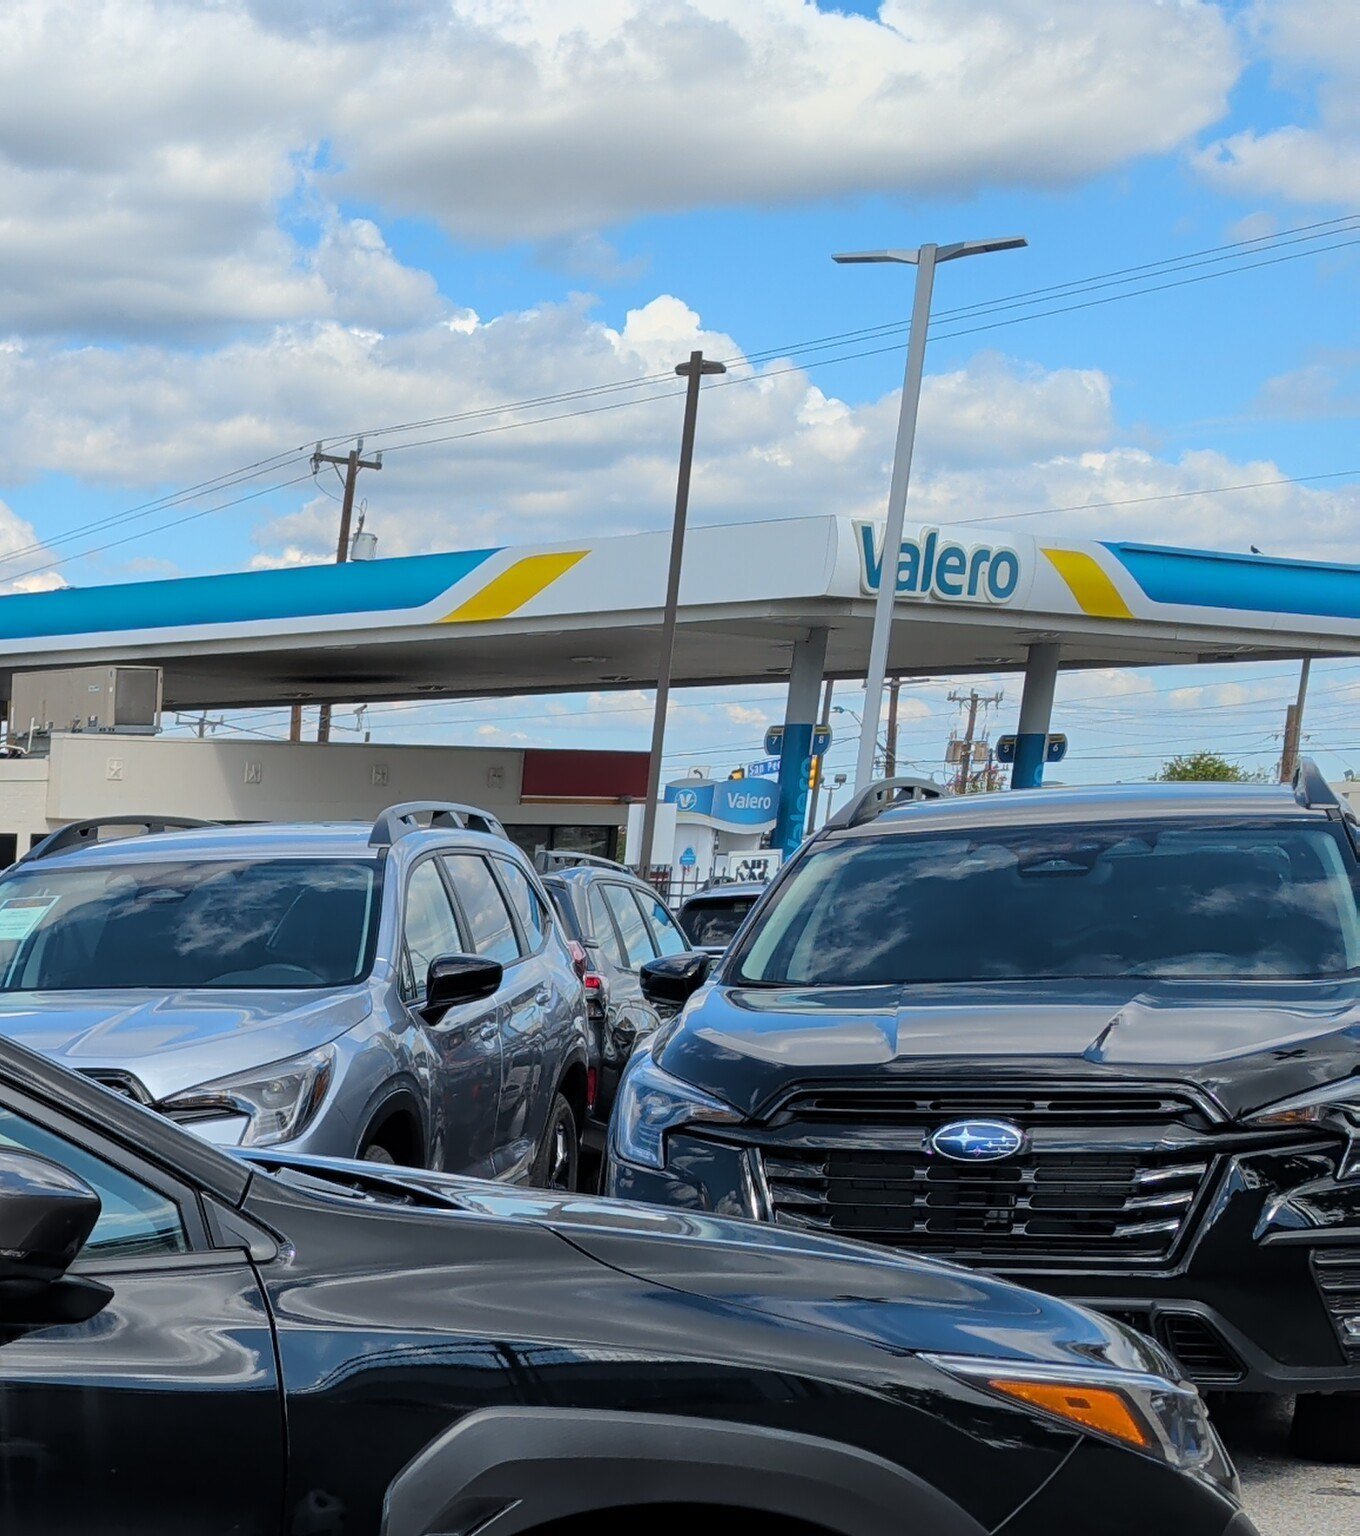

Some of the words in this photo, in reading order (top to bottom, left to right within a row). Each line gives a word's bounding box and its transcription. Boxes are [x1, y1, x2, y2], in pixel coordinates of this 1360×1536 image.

[857, 523, 1020, 600] Valero
[770, 735, 778, 745] 7
[1052, 743, 1059, 752] 6
[749, 763, 764, 776] San
[727, 792, 771, 810] Valero
